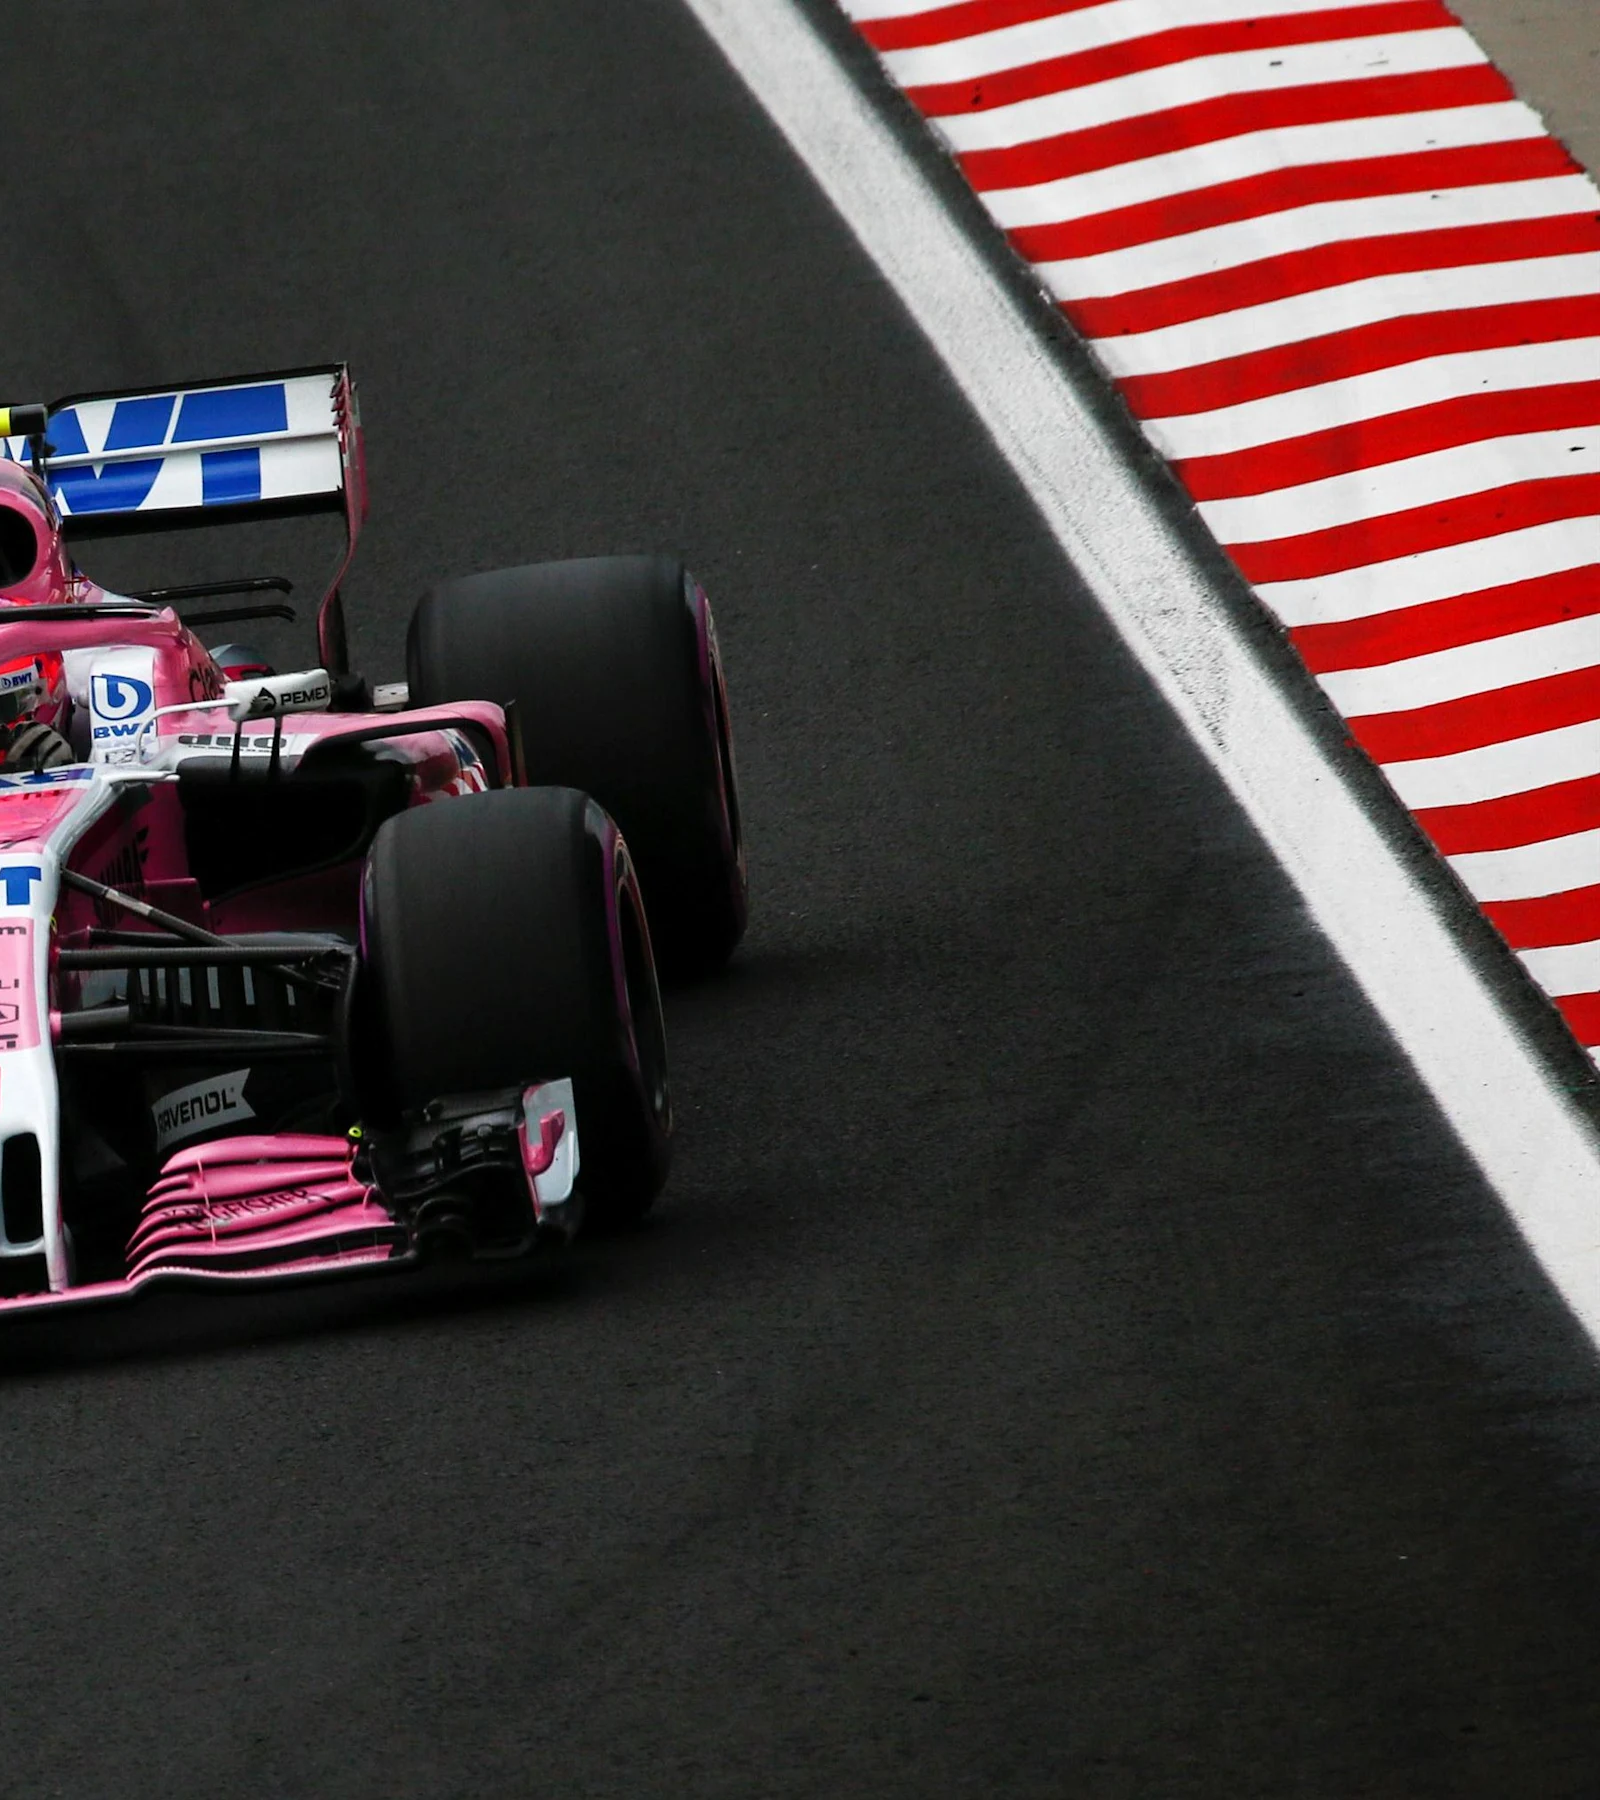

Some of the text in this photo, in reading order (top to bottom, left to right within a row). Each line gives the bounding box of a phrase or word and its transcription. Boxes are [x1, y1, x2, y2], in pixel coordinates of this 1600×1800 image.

[12, 672, 33, 687] BWT
[280, 684, 330, 706] PEMEX
[93, 721, 154, 739] BWT
